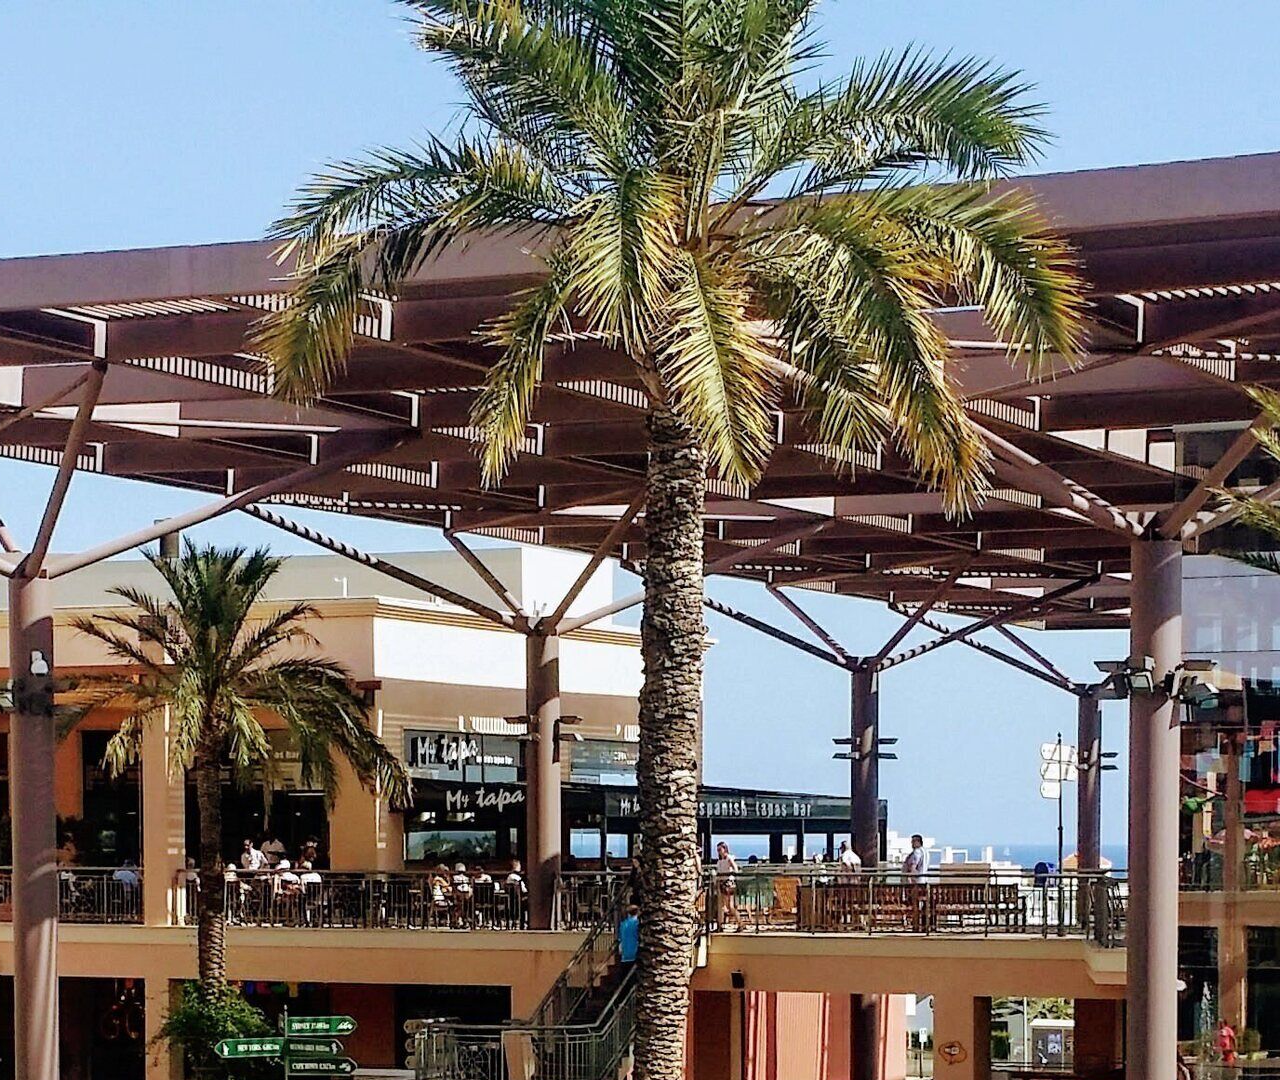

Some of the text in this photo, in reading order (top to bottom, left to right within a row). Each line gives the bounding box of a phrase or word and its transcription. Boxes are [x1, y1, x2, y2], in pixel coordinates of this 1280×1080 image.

[441, 734, 479, 770] tapa
[446, 786, 525, 813] My tapa
[699, 799, 811, 818] spanish tapas bar
